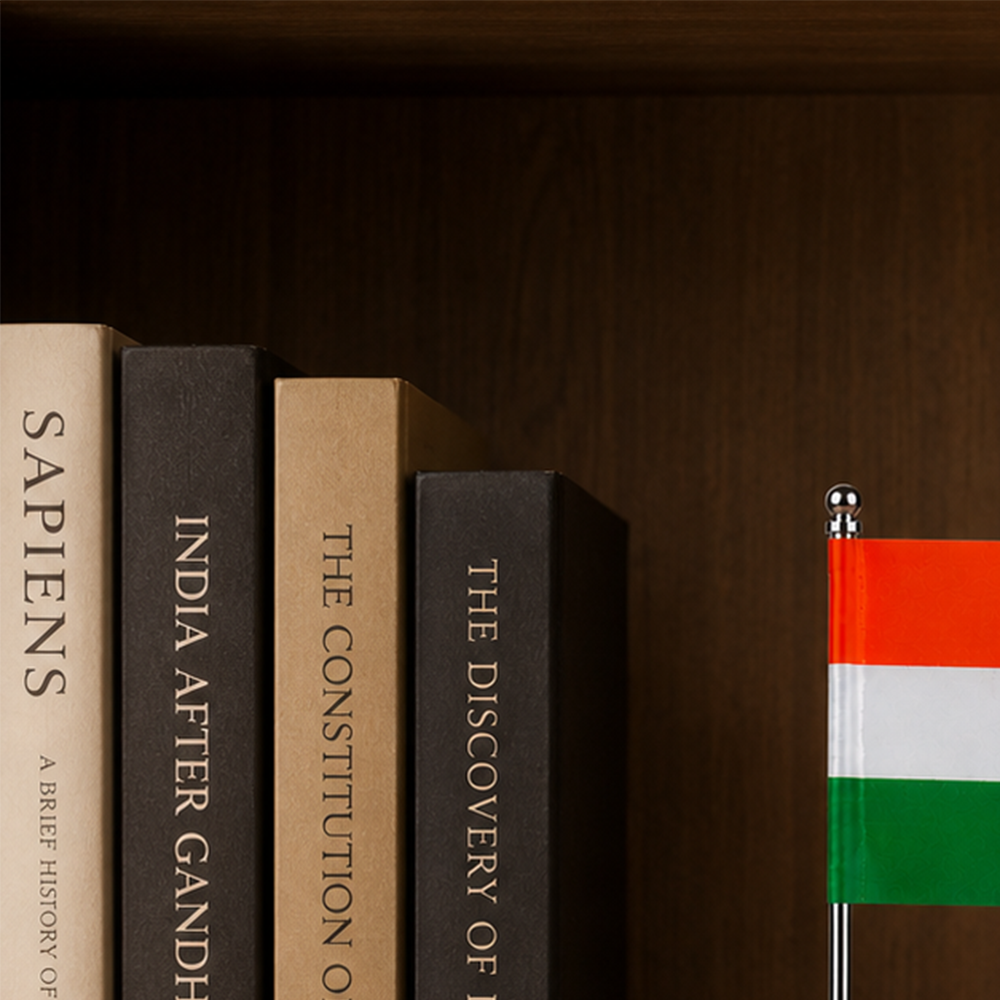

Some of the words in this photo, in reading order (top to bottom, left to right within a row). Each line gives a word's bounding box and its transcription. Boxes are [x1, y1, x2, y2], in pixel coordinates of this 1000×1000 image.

[22, 409, 67, 698] SAPIENS
[174, 514, 210, 652] INDIA
[322, 523, 354, 609] THE
[467, 558, 499, 643] THE
[39, 754, 57, 772] A
[174, 667, 210, 817] AFTER
[321, 624, 354, 948] CONSTITUTION
[466, 661, 499, 905] DISCOVERY
[39, 781, 57, 851] BRIEF
[39, 859, 58, 960] HISTORY
[466, 920, 498, 976] OF
[39, 967, 58, 999] OF
